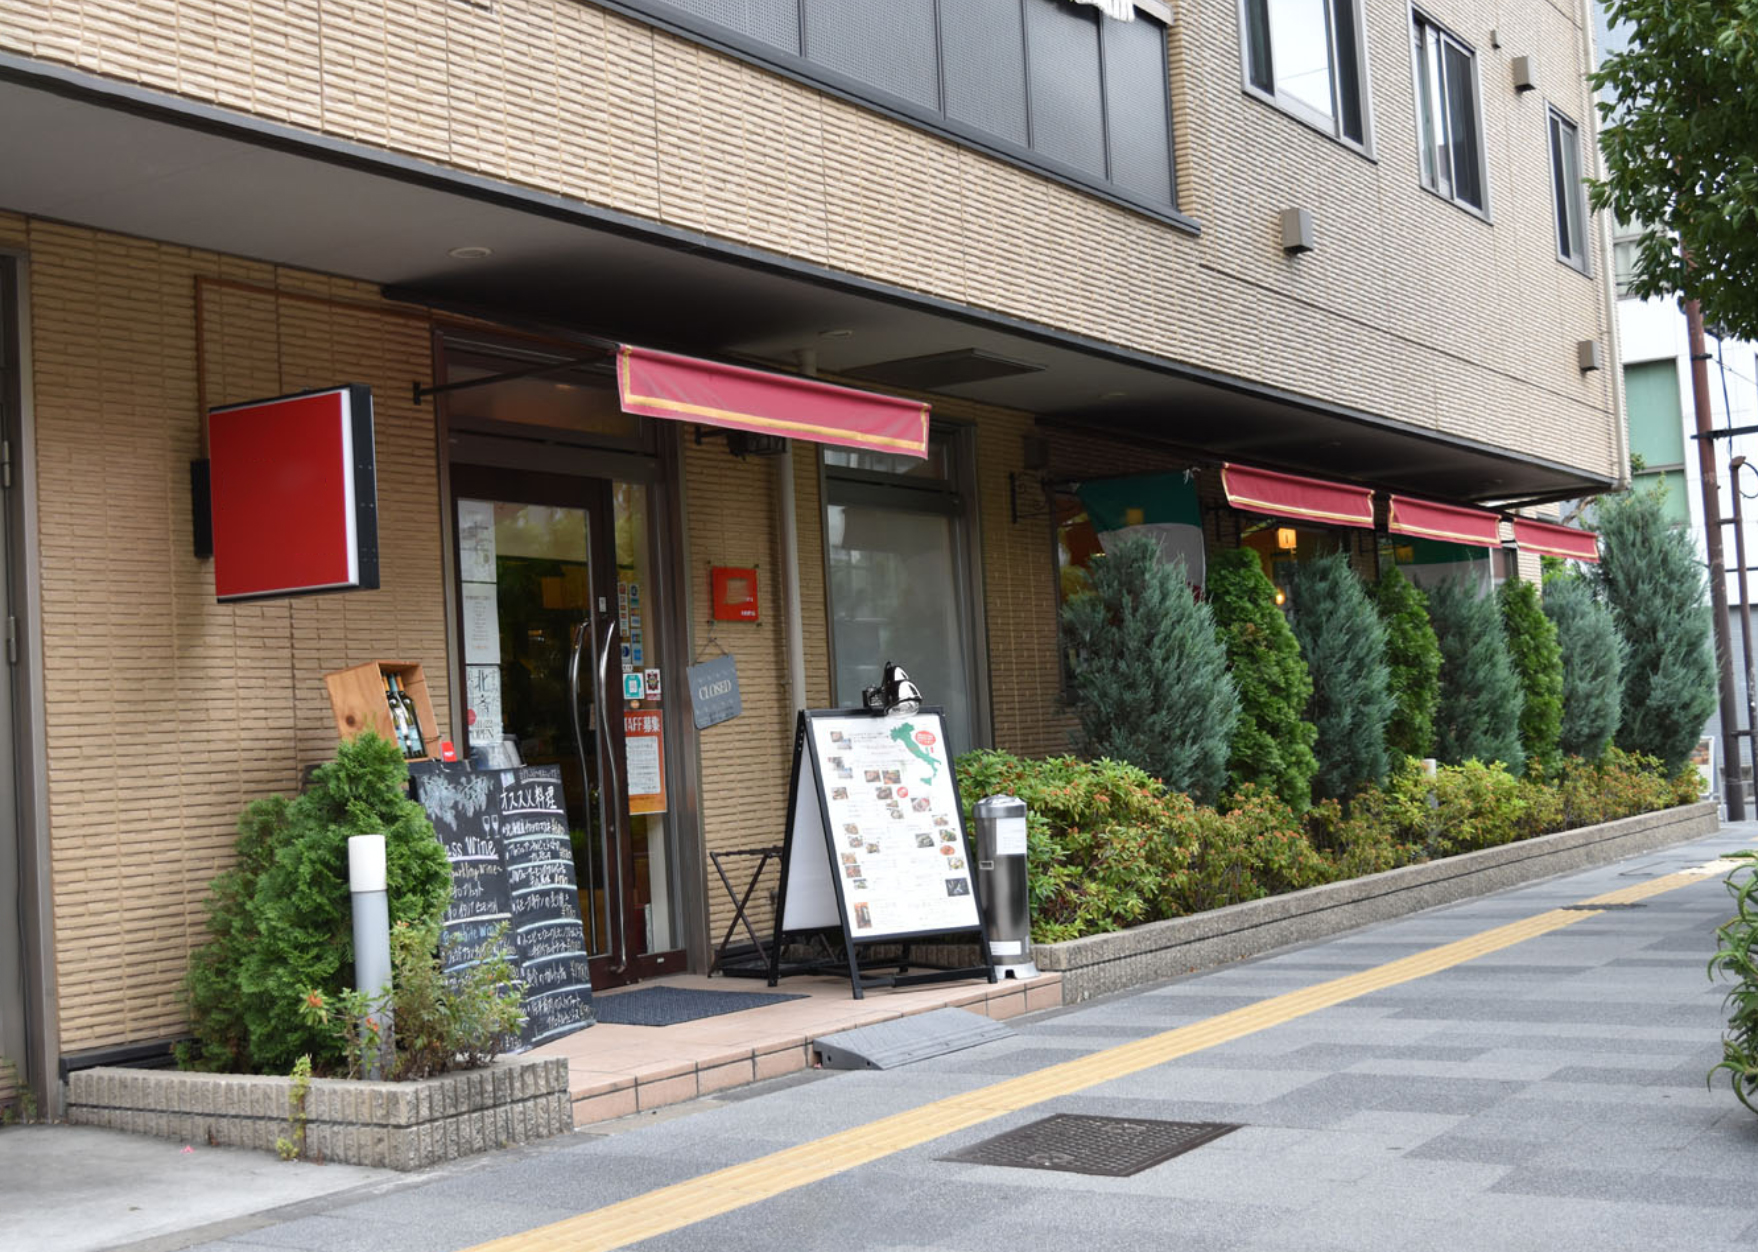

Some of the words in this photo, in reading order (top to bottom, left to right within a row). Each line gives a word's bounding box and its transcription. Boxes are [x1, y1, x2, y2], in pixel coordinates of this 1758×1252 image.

[699, 680, 731, 700] CLOSED
[499, 784, 557, 810] オススメ料理
[465, 835, 496, 856] Wine
